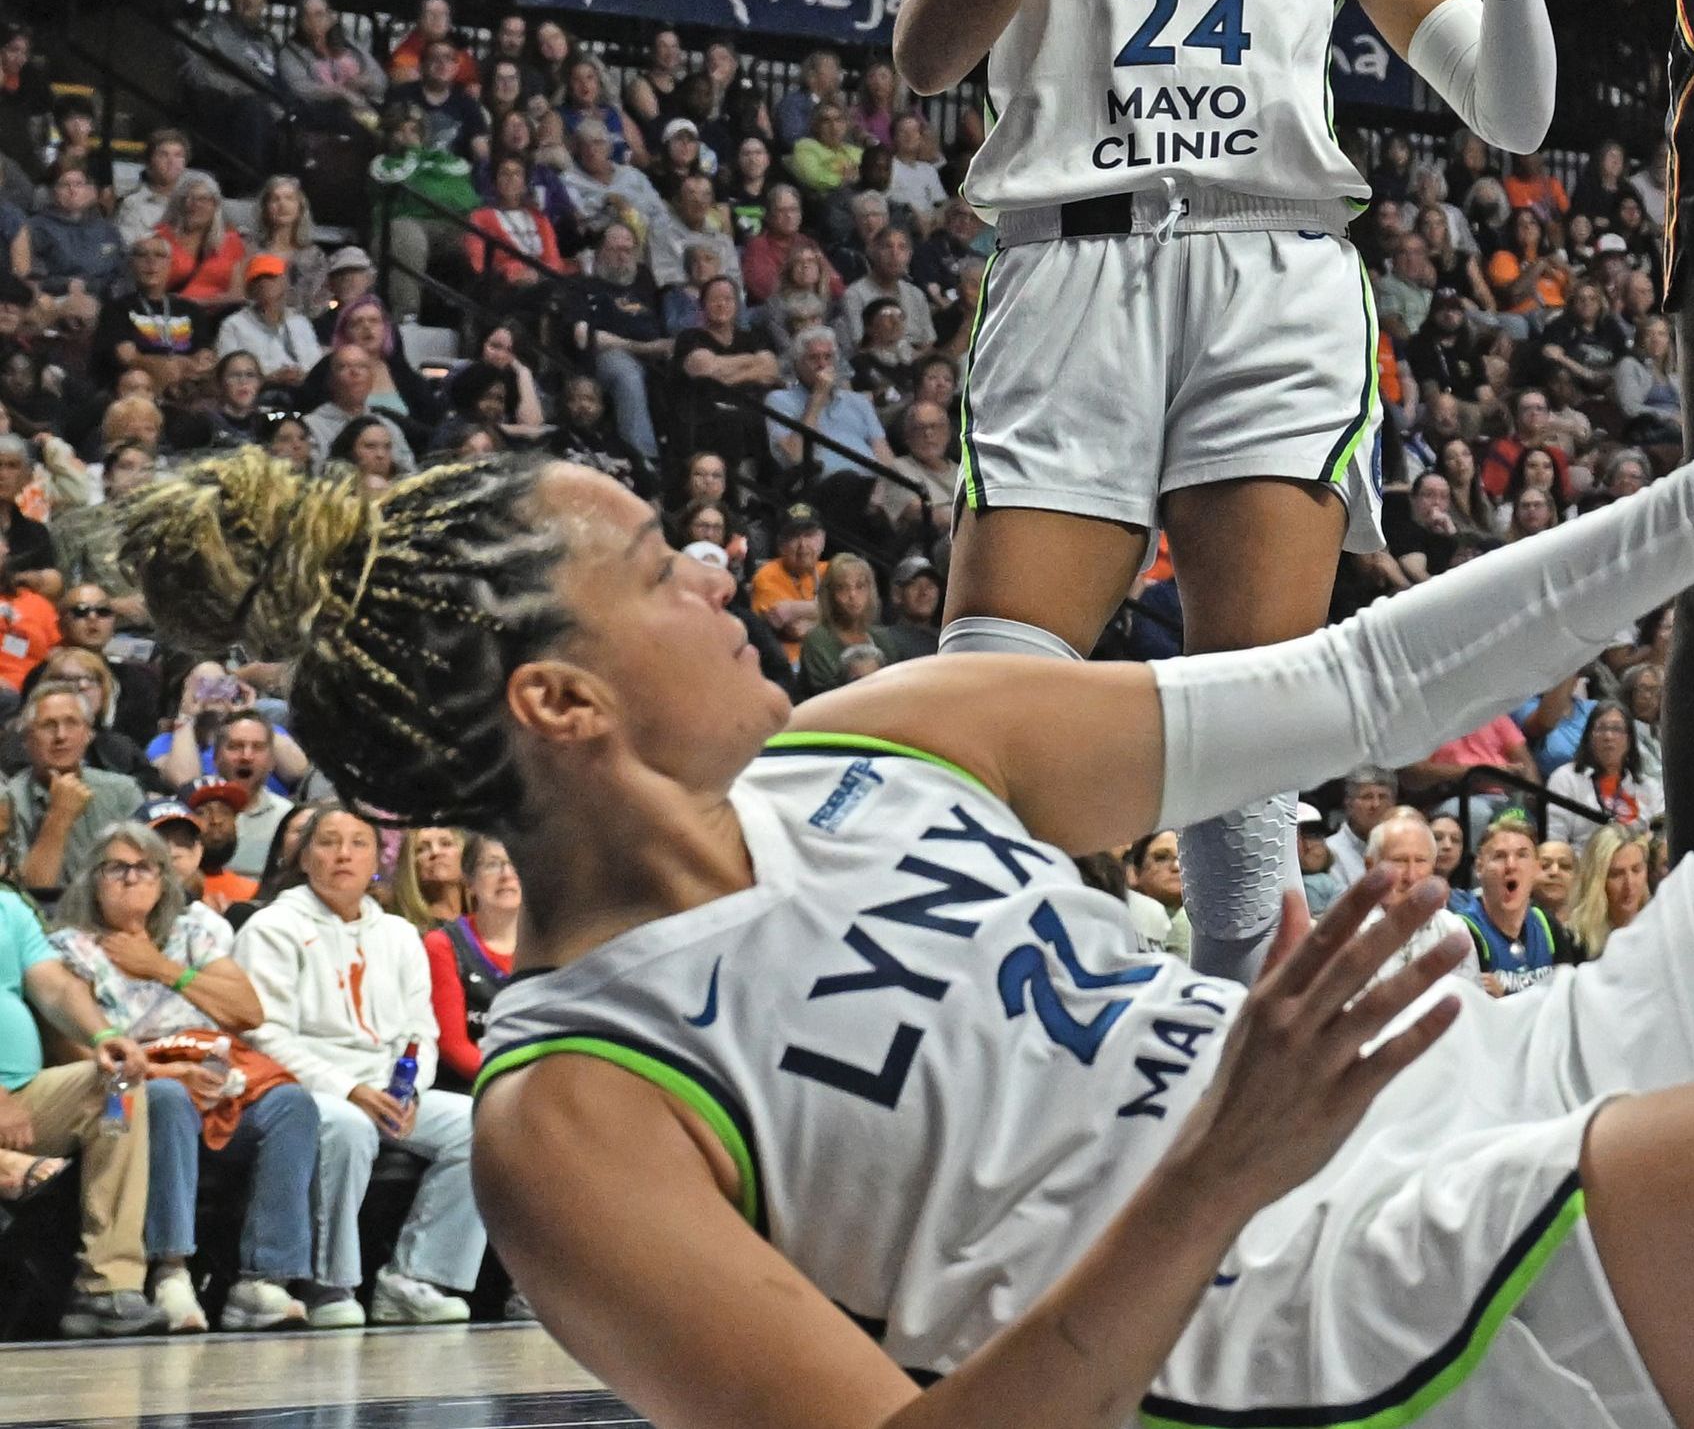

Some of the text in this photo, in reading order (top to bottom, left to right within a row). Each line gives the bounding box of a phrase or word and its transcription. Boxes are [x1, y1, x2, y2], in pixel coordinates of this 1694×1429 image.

[1106, 85, 1246, 125] MAYO
[1091, 129, 1259, 170] CLINIC
[779, 803, 1054, 1111] LYNX
